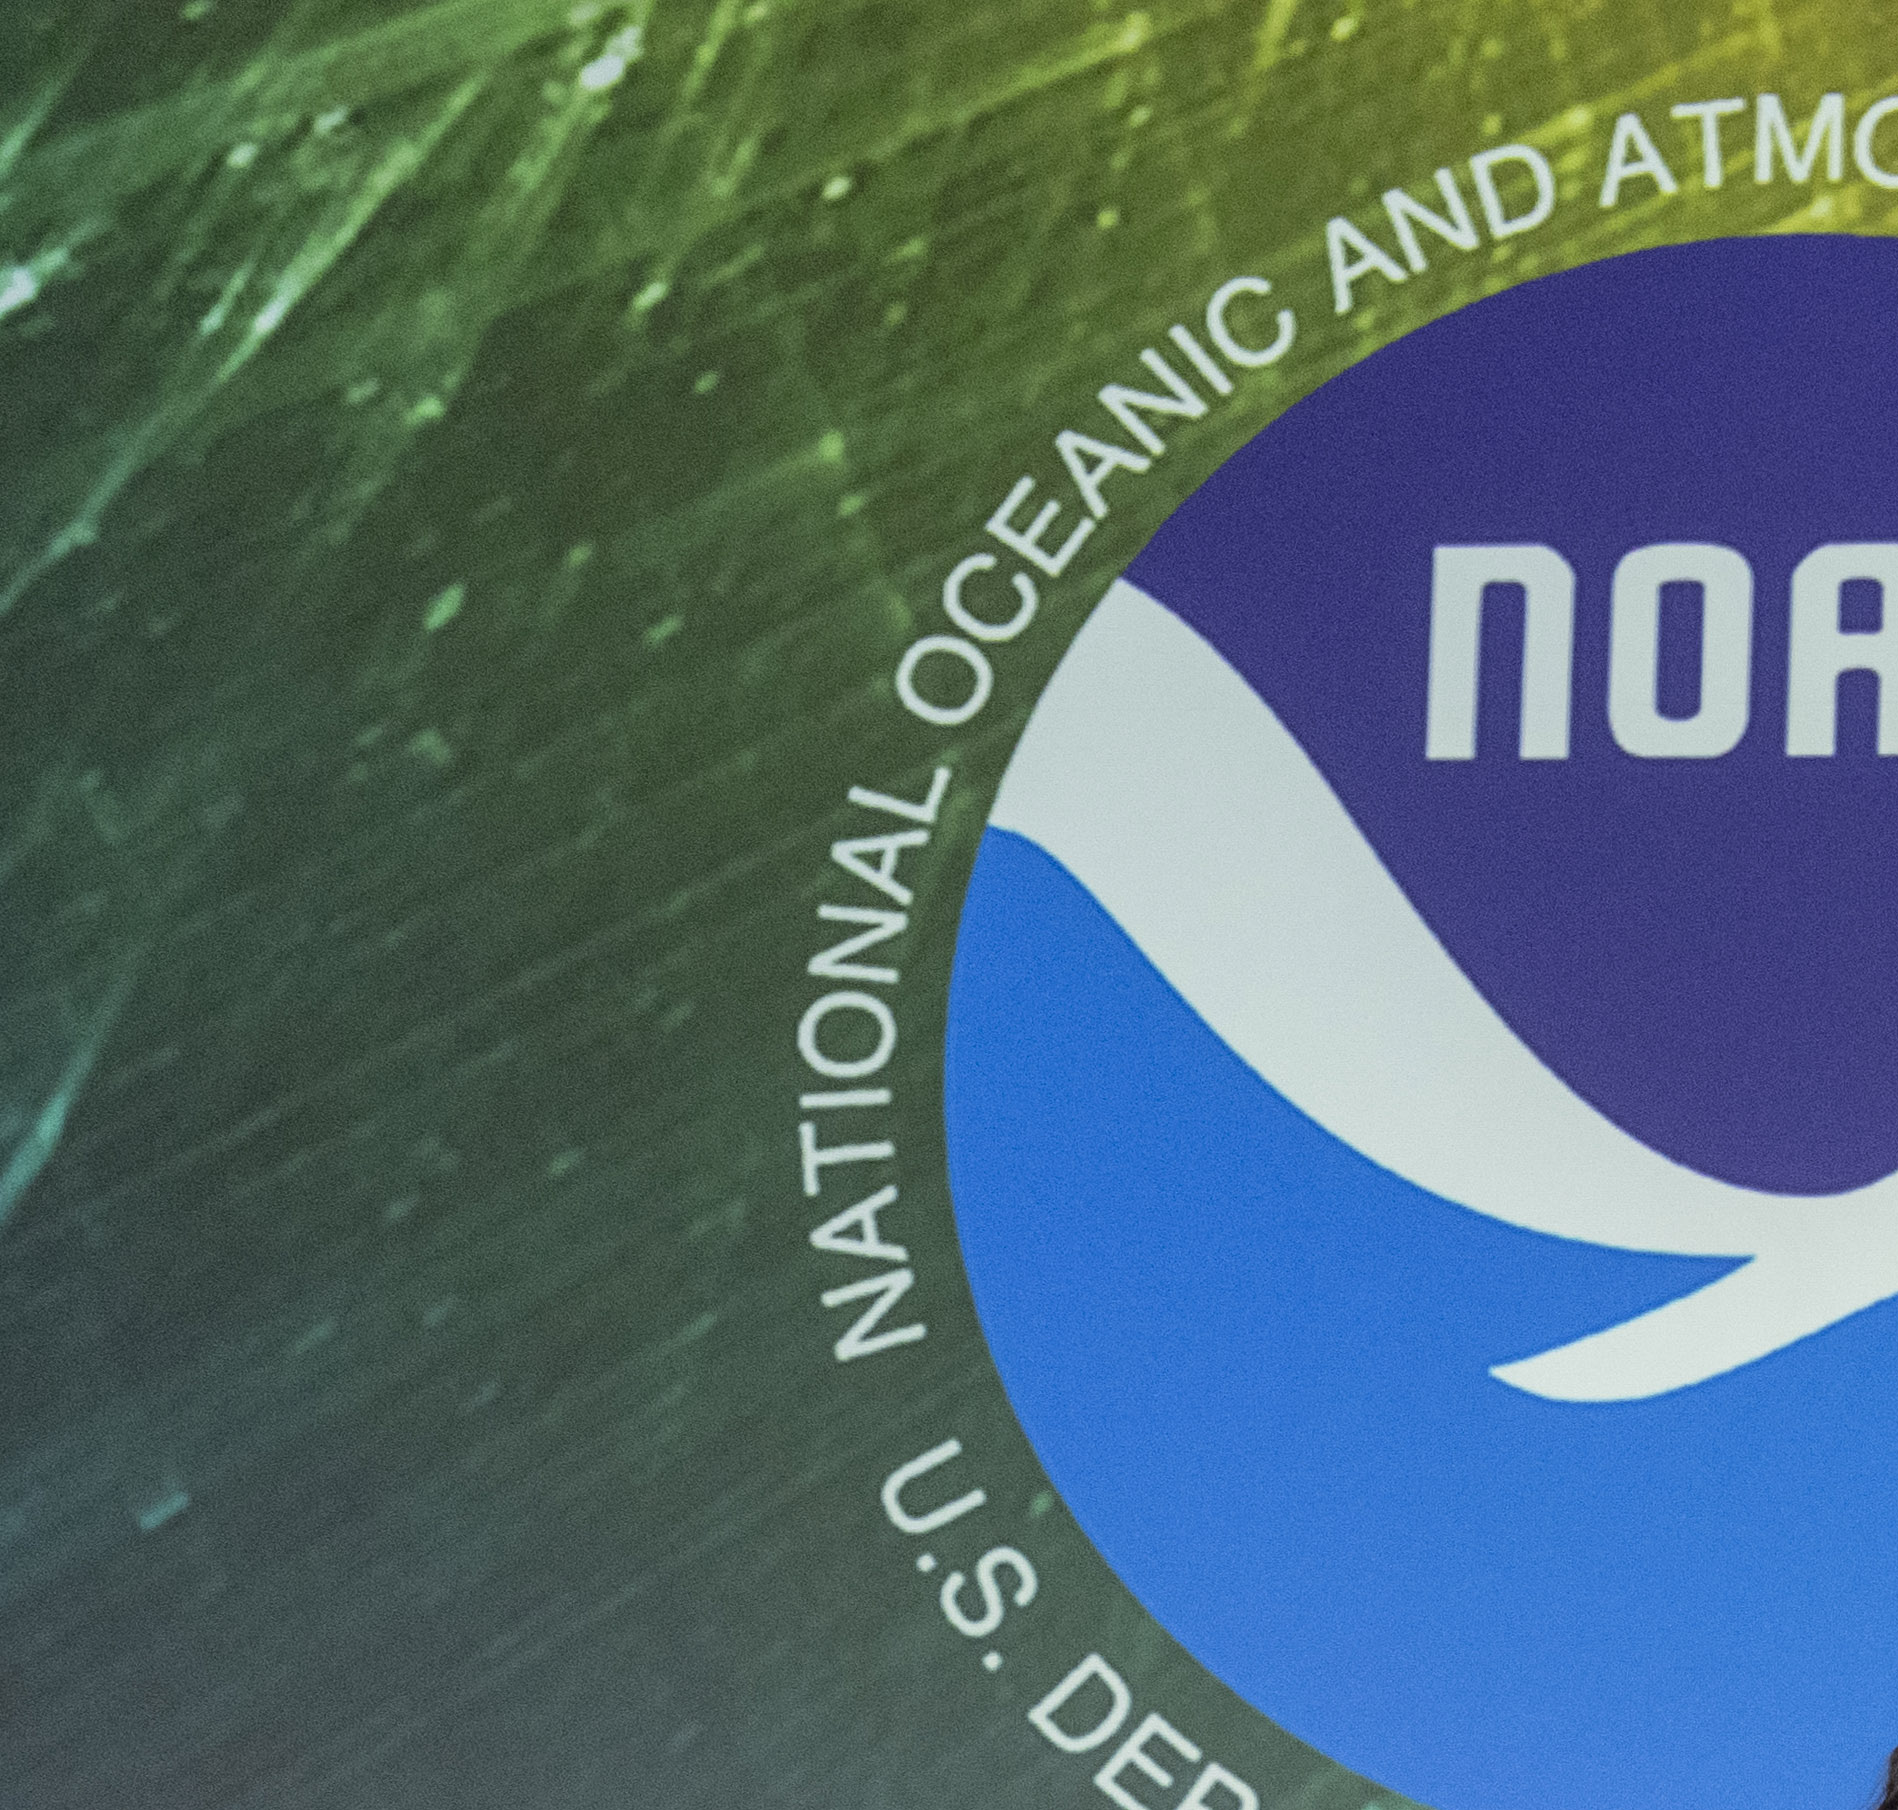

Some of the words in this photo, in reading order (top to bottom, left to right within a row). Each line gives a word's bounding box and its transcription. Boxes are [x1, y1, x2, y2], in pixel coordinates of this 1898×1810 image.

[798, 765, 952, 1362] NATIONAL
[894, 274, 1297, 727] OCEANIC
[1324, 141, 1557, 314] AND
[880, 1438, 1039, 1671] U.S.
